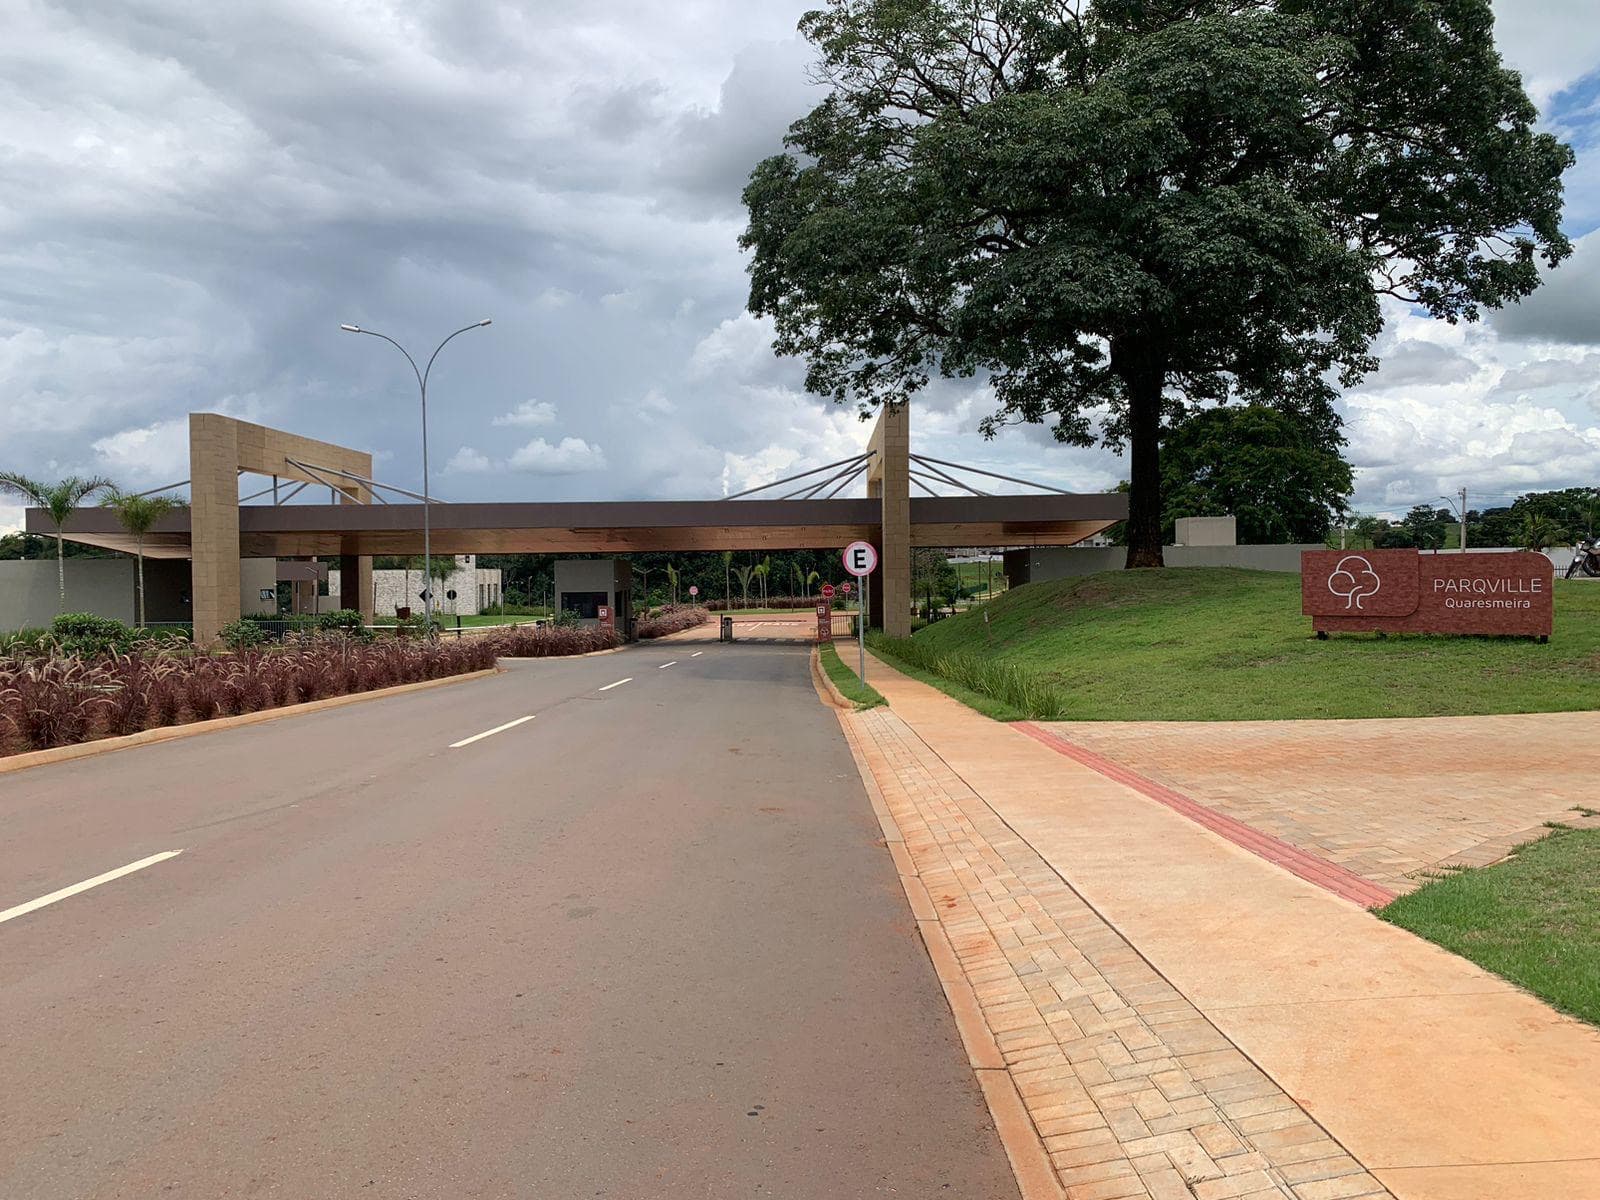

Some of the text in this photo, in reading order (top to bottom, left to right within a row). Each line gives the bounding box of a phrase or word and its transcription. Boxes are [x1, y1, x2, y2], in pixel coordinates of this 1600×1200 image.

[854, 549, 867, 568] E
[1433, 578, 1542, 594] PARQVILLE
[1445, 597, 1531, 609] Quaresmeira
